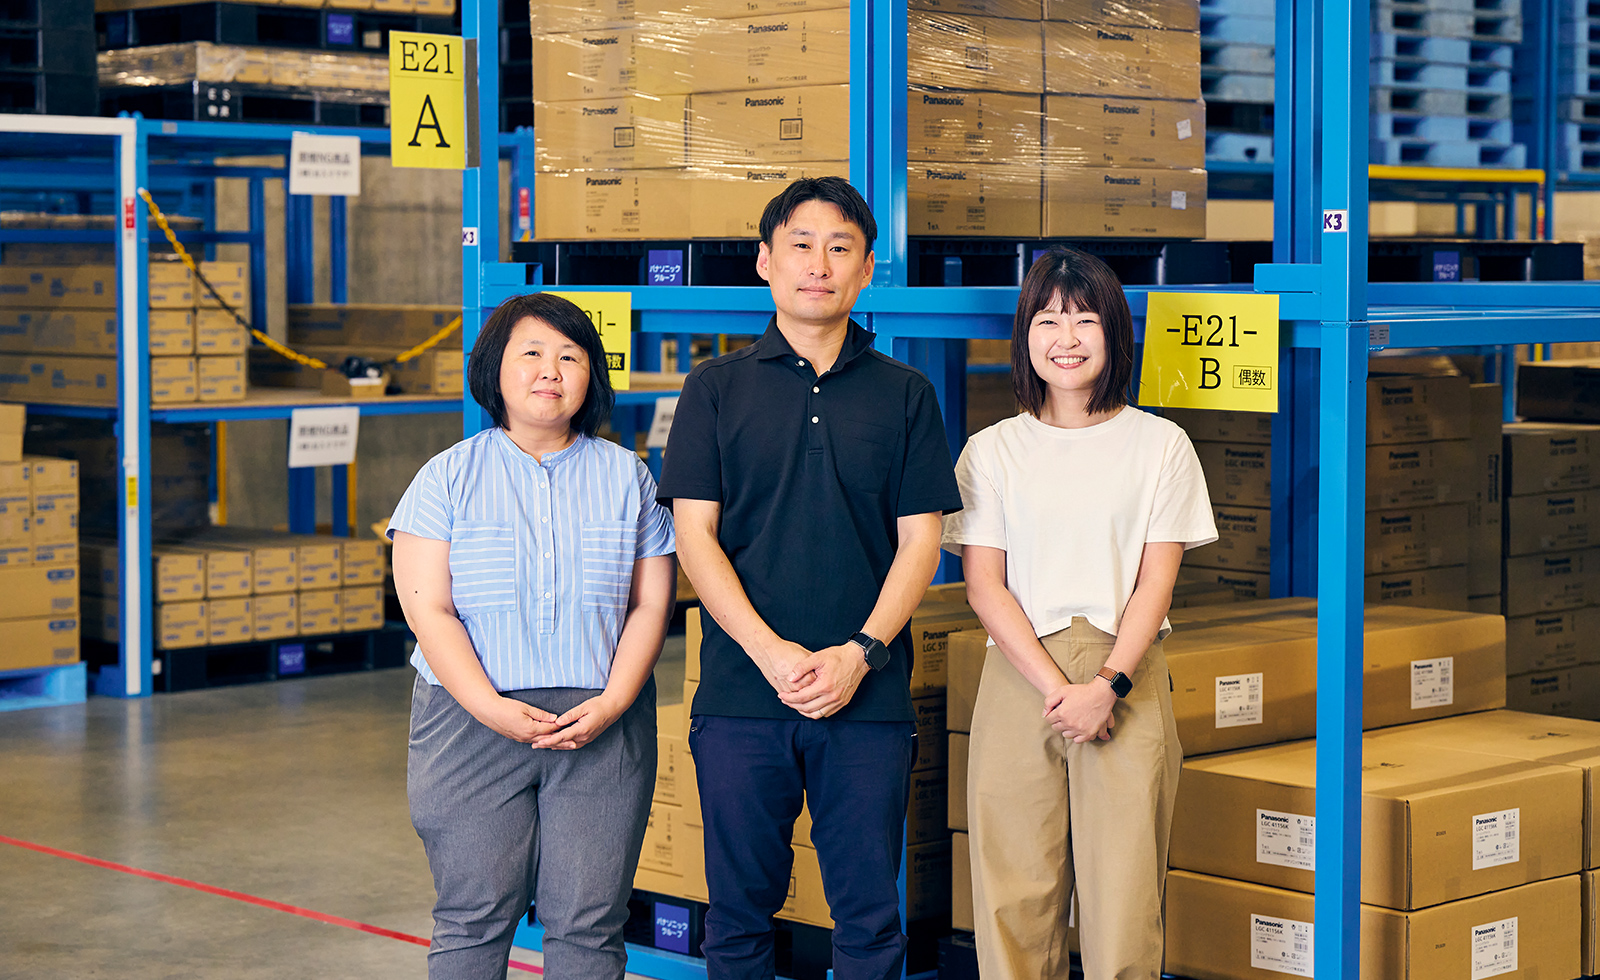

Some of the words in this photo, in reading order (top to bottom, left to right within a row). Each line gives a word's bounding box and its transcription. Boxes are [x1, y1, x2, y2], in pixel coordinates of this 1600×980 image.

[747, 22, 789, 33] Panasonic
[400, 41, 453, 74] E21
[745, 96, 785, 107] Panasonic
[923, 95, 966, 106] Panasonic
[582, 105, 618, 116] Panasonic
[1103, 104, 1140, 114] Panasonic
[408, 94, 450, 148] A
[747, 171, 788, 181] Panasonic
[926, 170, 967, 180] Panasonic
[1104, 175, 1141, 185] Panasonic
[586, 176, 622, 186] Panasonic
[1323, 213, 1342, 230] K3
[463, 231, 474, 243] K3
[649, 264, 681, 273] パナソニック
[654, 273, 676, 282] グループ
[1166, 314, 1258, 348] -E21-
[1198, 357, 1222, 390] B
[1238, 368, 1266, 386] 偶数
[1225, 448, 1265, 459] Panasonic
[1217, 511, 1258, 523] Panasonic
[923, 643, 937, 652] LGC
[1261, 813, 1289, 823] Panasonic
[1475, 817, 1497, 825] Panasonic
[1271, 821, 1289, 829] 41156K
[656, 917, 688, 930] パナソニック
[1255, 918, 1283, 929] Panasonic
[1265, 927, 1284, 935] 41156K
[1475, 926, 1496, 936] Panasonic
